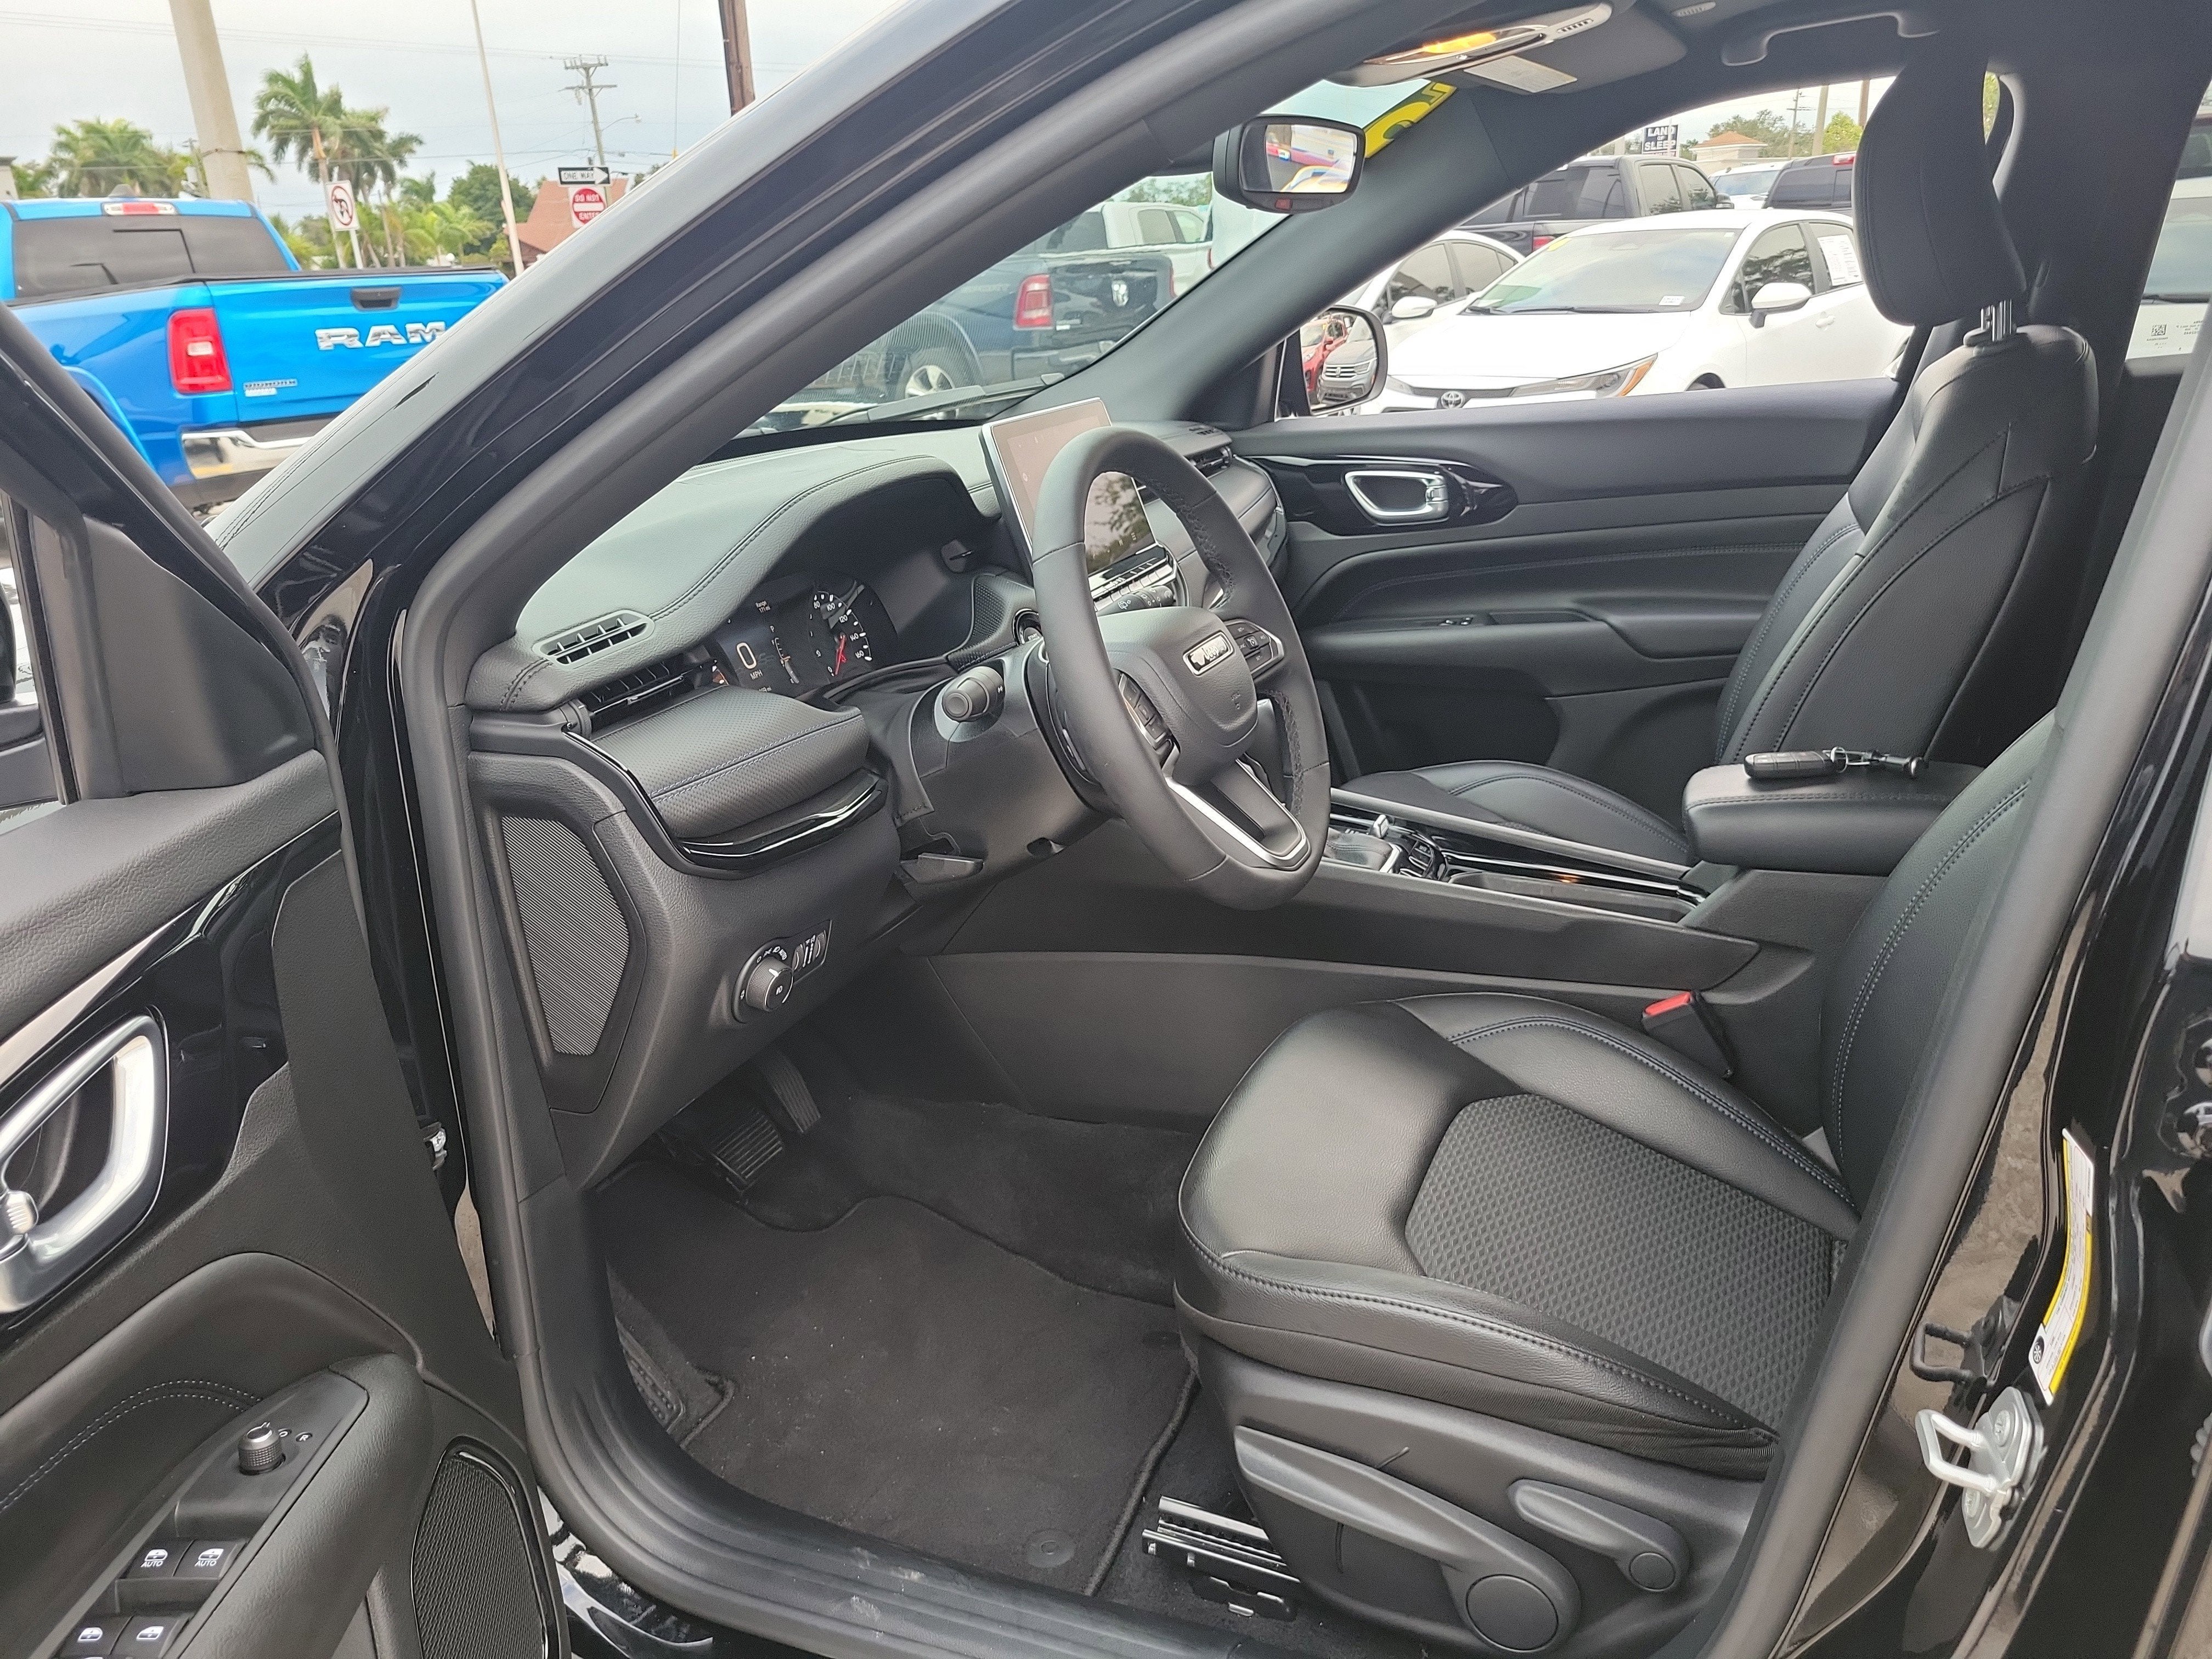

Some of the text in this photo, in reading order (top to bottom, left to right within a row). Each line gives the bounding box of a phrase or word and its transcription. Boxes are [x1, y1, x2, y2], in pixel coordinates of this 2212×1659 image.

[1647, 126, 1675, 137] LAND
[1644, 140, 1676, 151] SLEEP
[563, 172, 577, 180] ONE
[574, 194, 600, 202] DO NOT
[315, 321, 446, 351] RAM
[826, 602, 836, 612] 100
[839, 614, 848, 623] 120
[850, 633, 859, 641] 140
[736, 642, 757, 669] 0
[855, 650, 865, 659] 160
[750, 669, 763, 680] MPH
